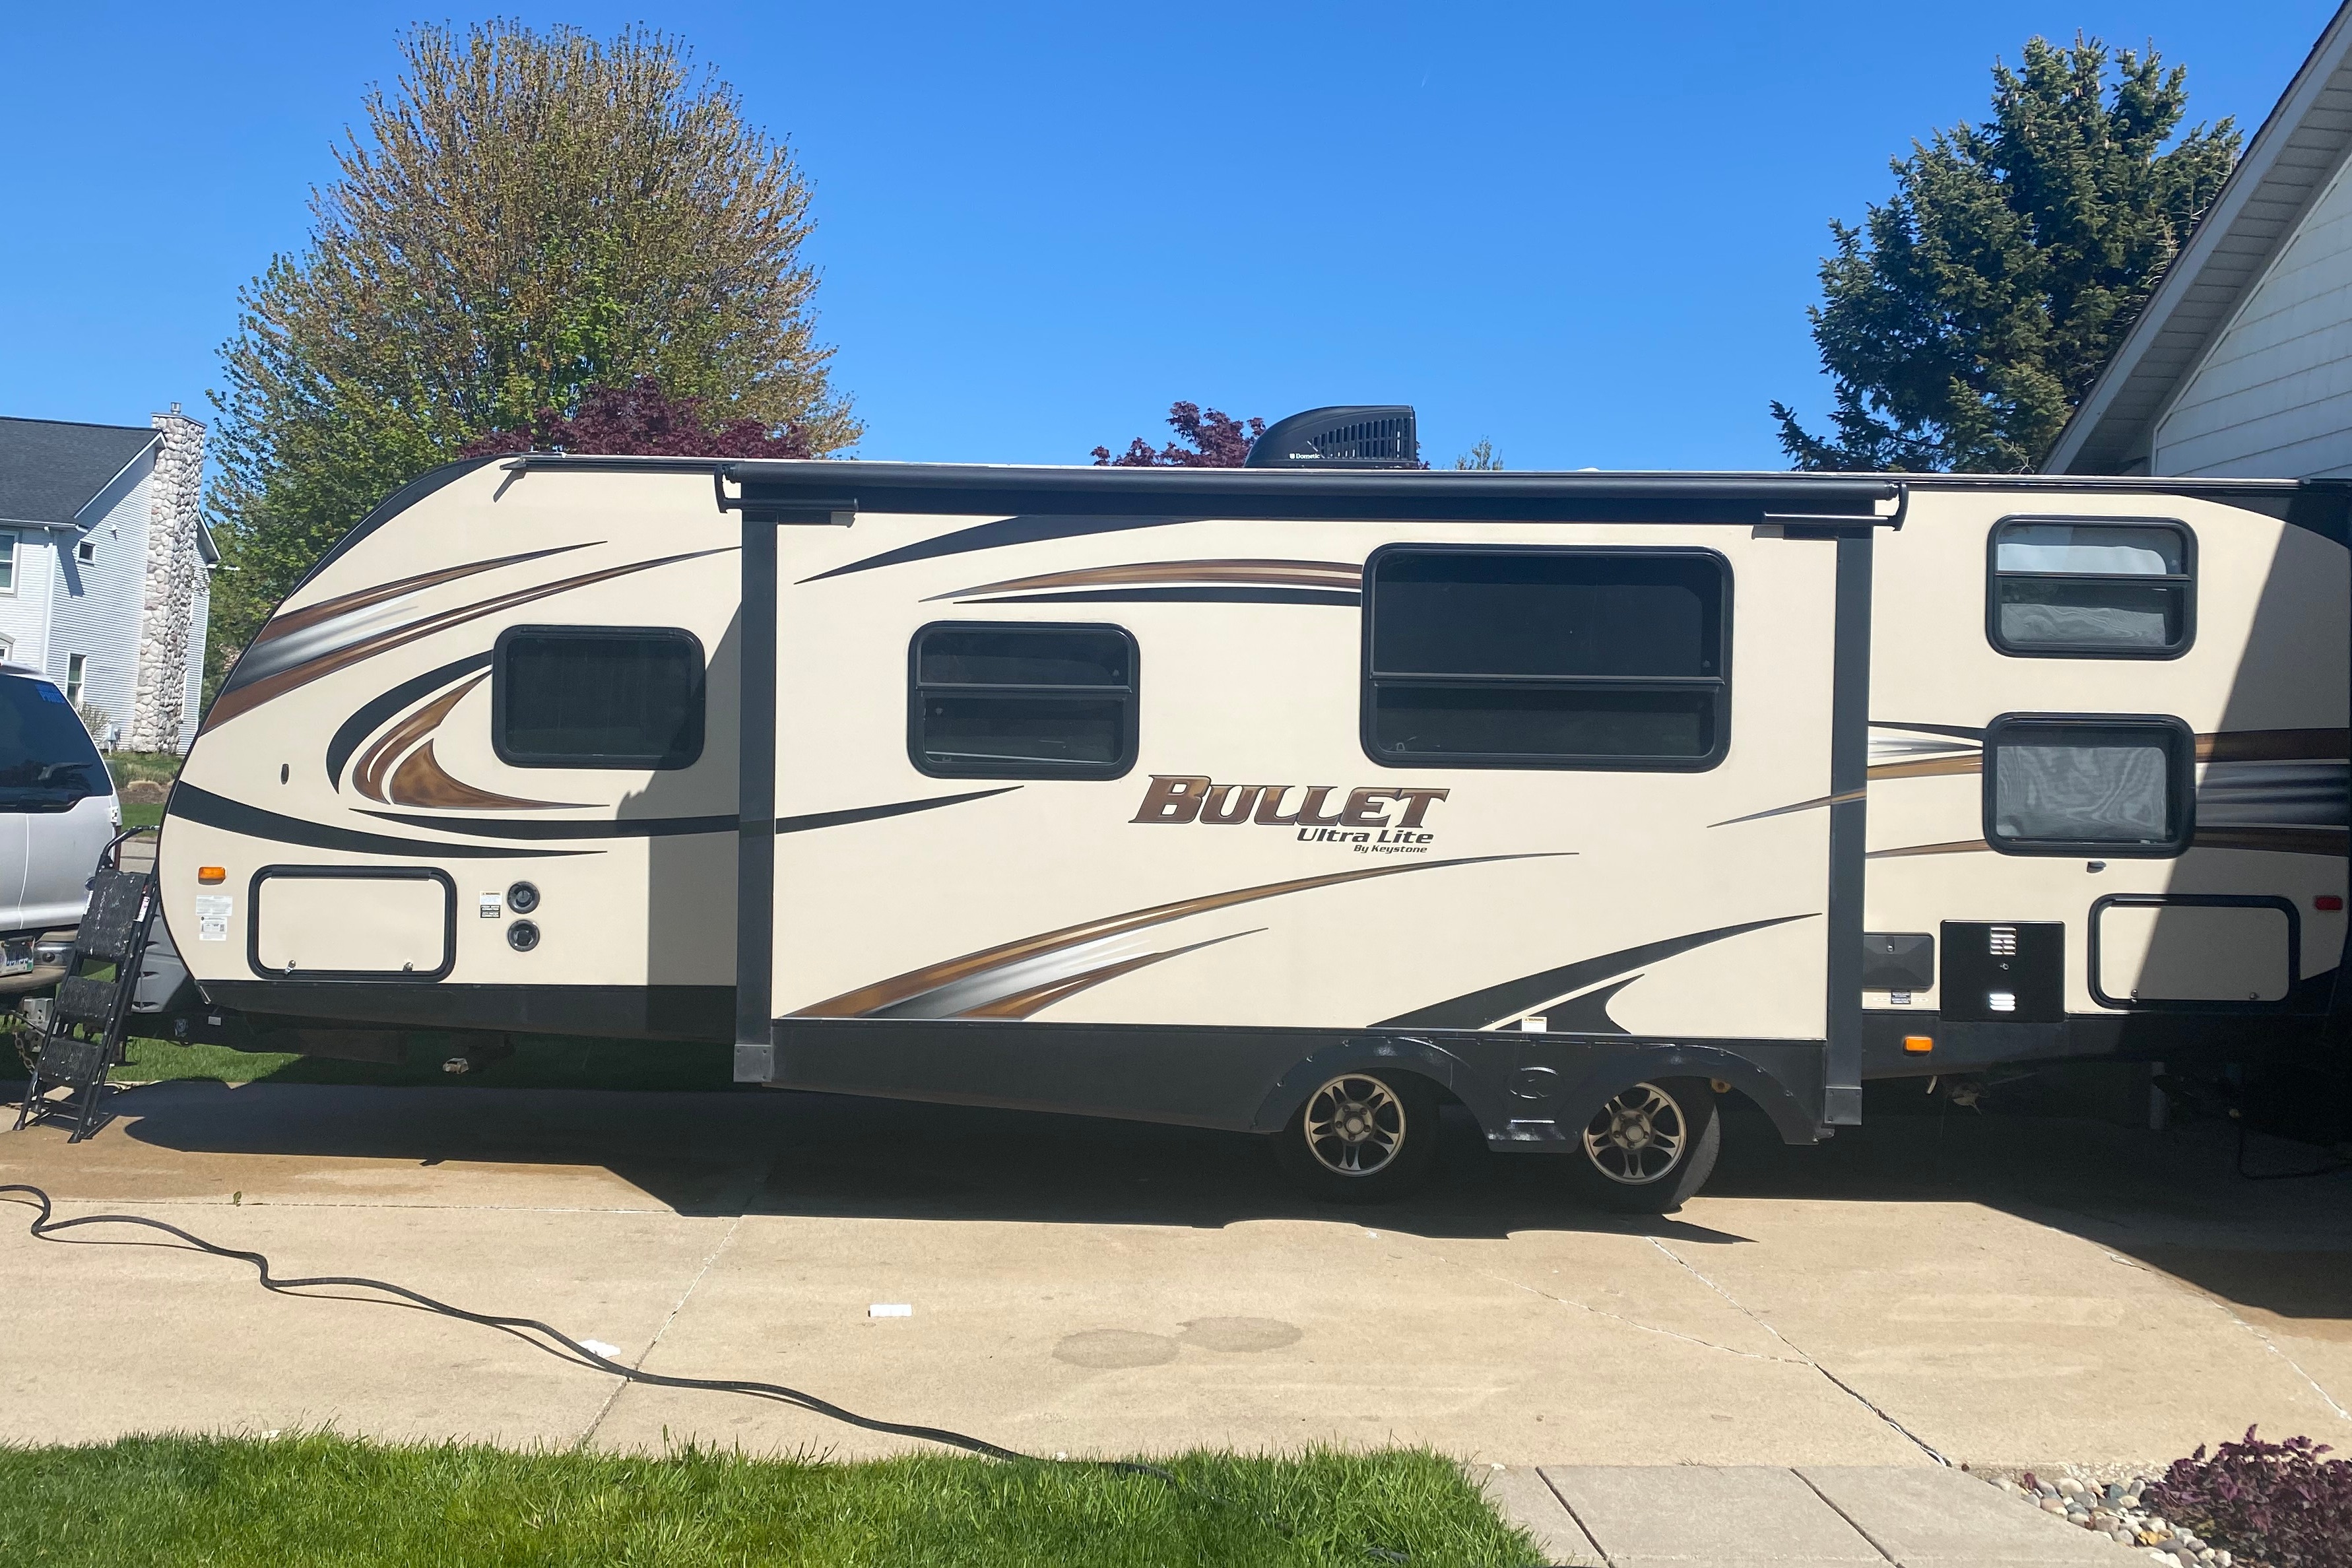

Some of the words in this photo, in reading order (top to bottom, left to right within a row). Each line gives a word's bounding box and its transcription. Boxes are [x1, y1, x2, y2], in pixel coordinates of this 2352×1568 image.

[1128, 774, 1451, 829] BULLET
[1297, 828, 1371, 842] Ultra
[1377, 829, 1434, 844] Lite
[1353, 844, 1369, 854] By
[1371, 845, 1427, 854] Keystone
